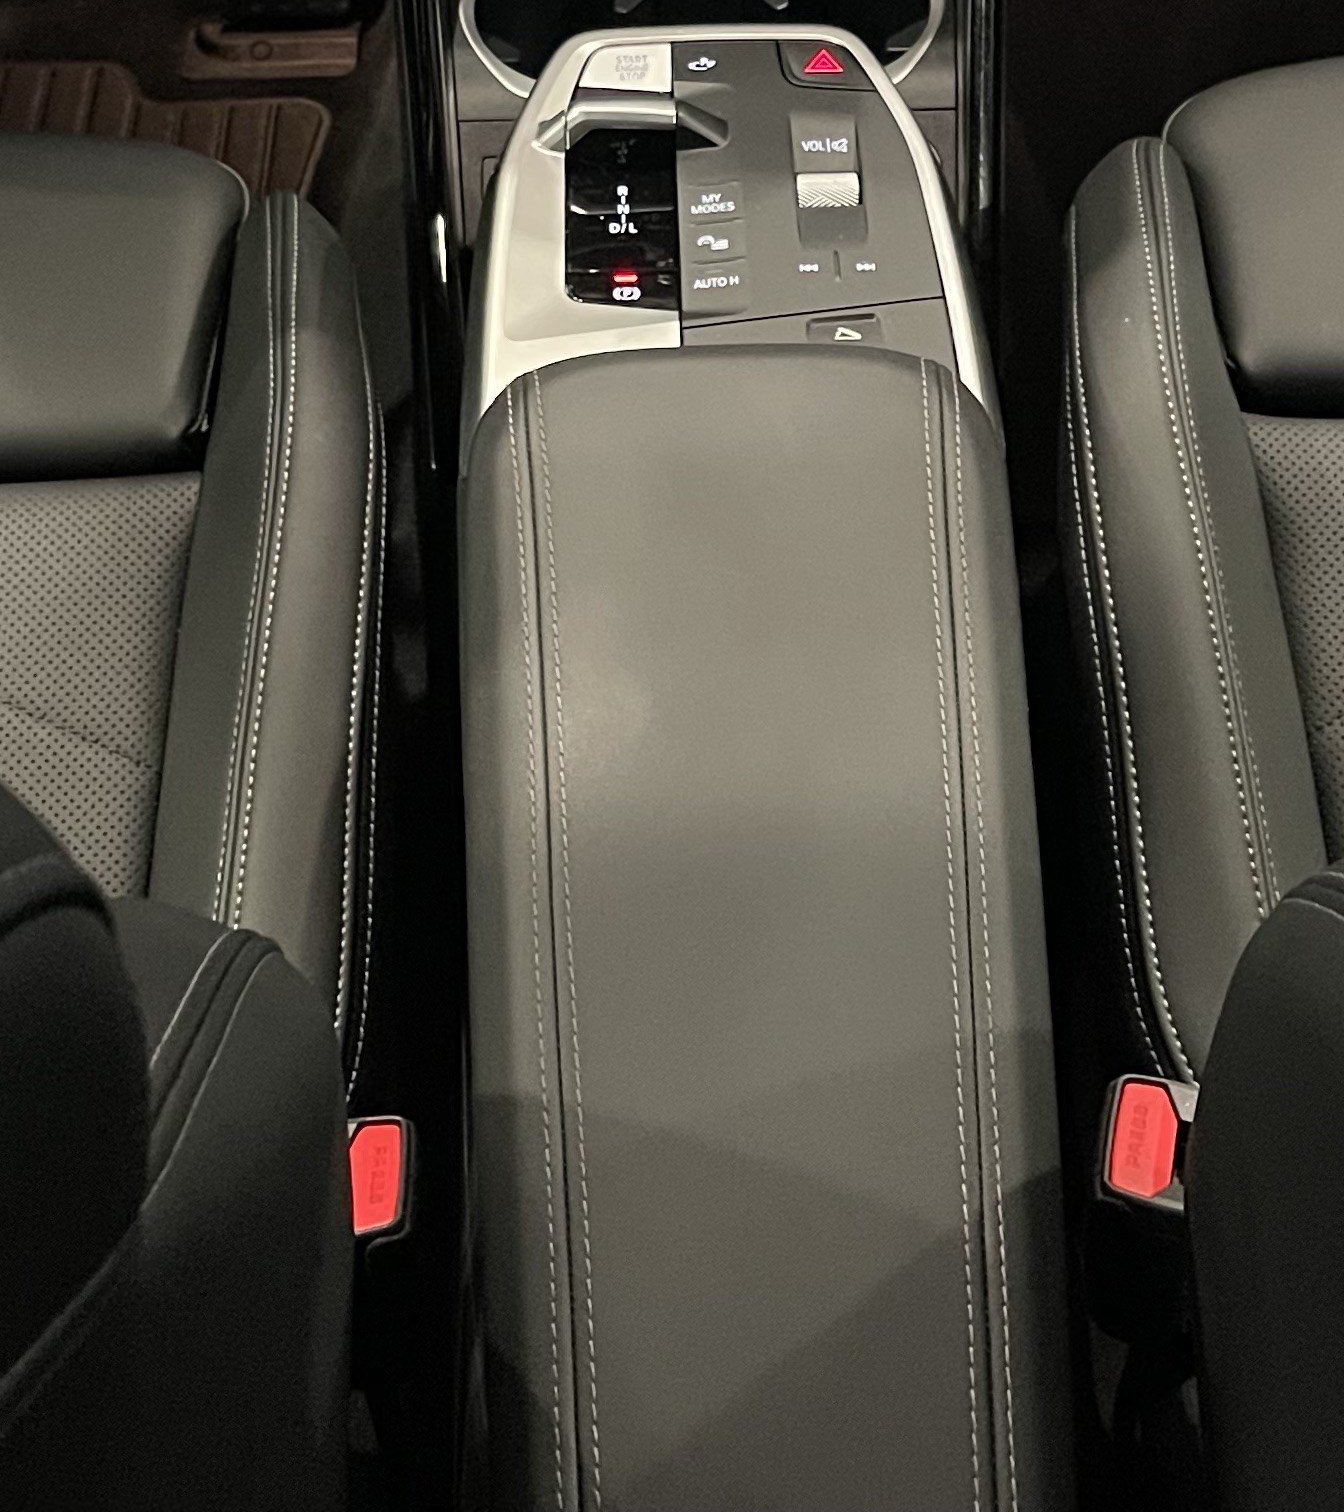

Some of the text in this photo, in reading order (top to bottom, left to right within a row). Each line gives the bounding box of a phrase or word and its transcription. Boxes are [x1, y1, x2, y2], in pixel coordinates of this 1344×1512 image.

[615, 55, 648, 64] START
[801, 139, 826, 152] VOL
[701, 193, 722, 204] MY
[616, 204, 630, 215] N
[690, 201, 736, 215] MODES
[693, 275, 740, 289] AUTO H
